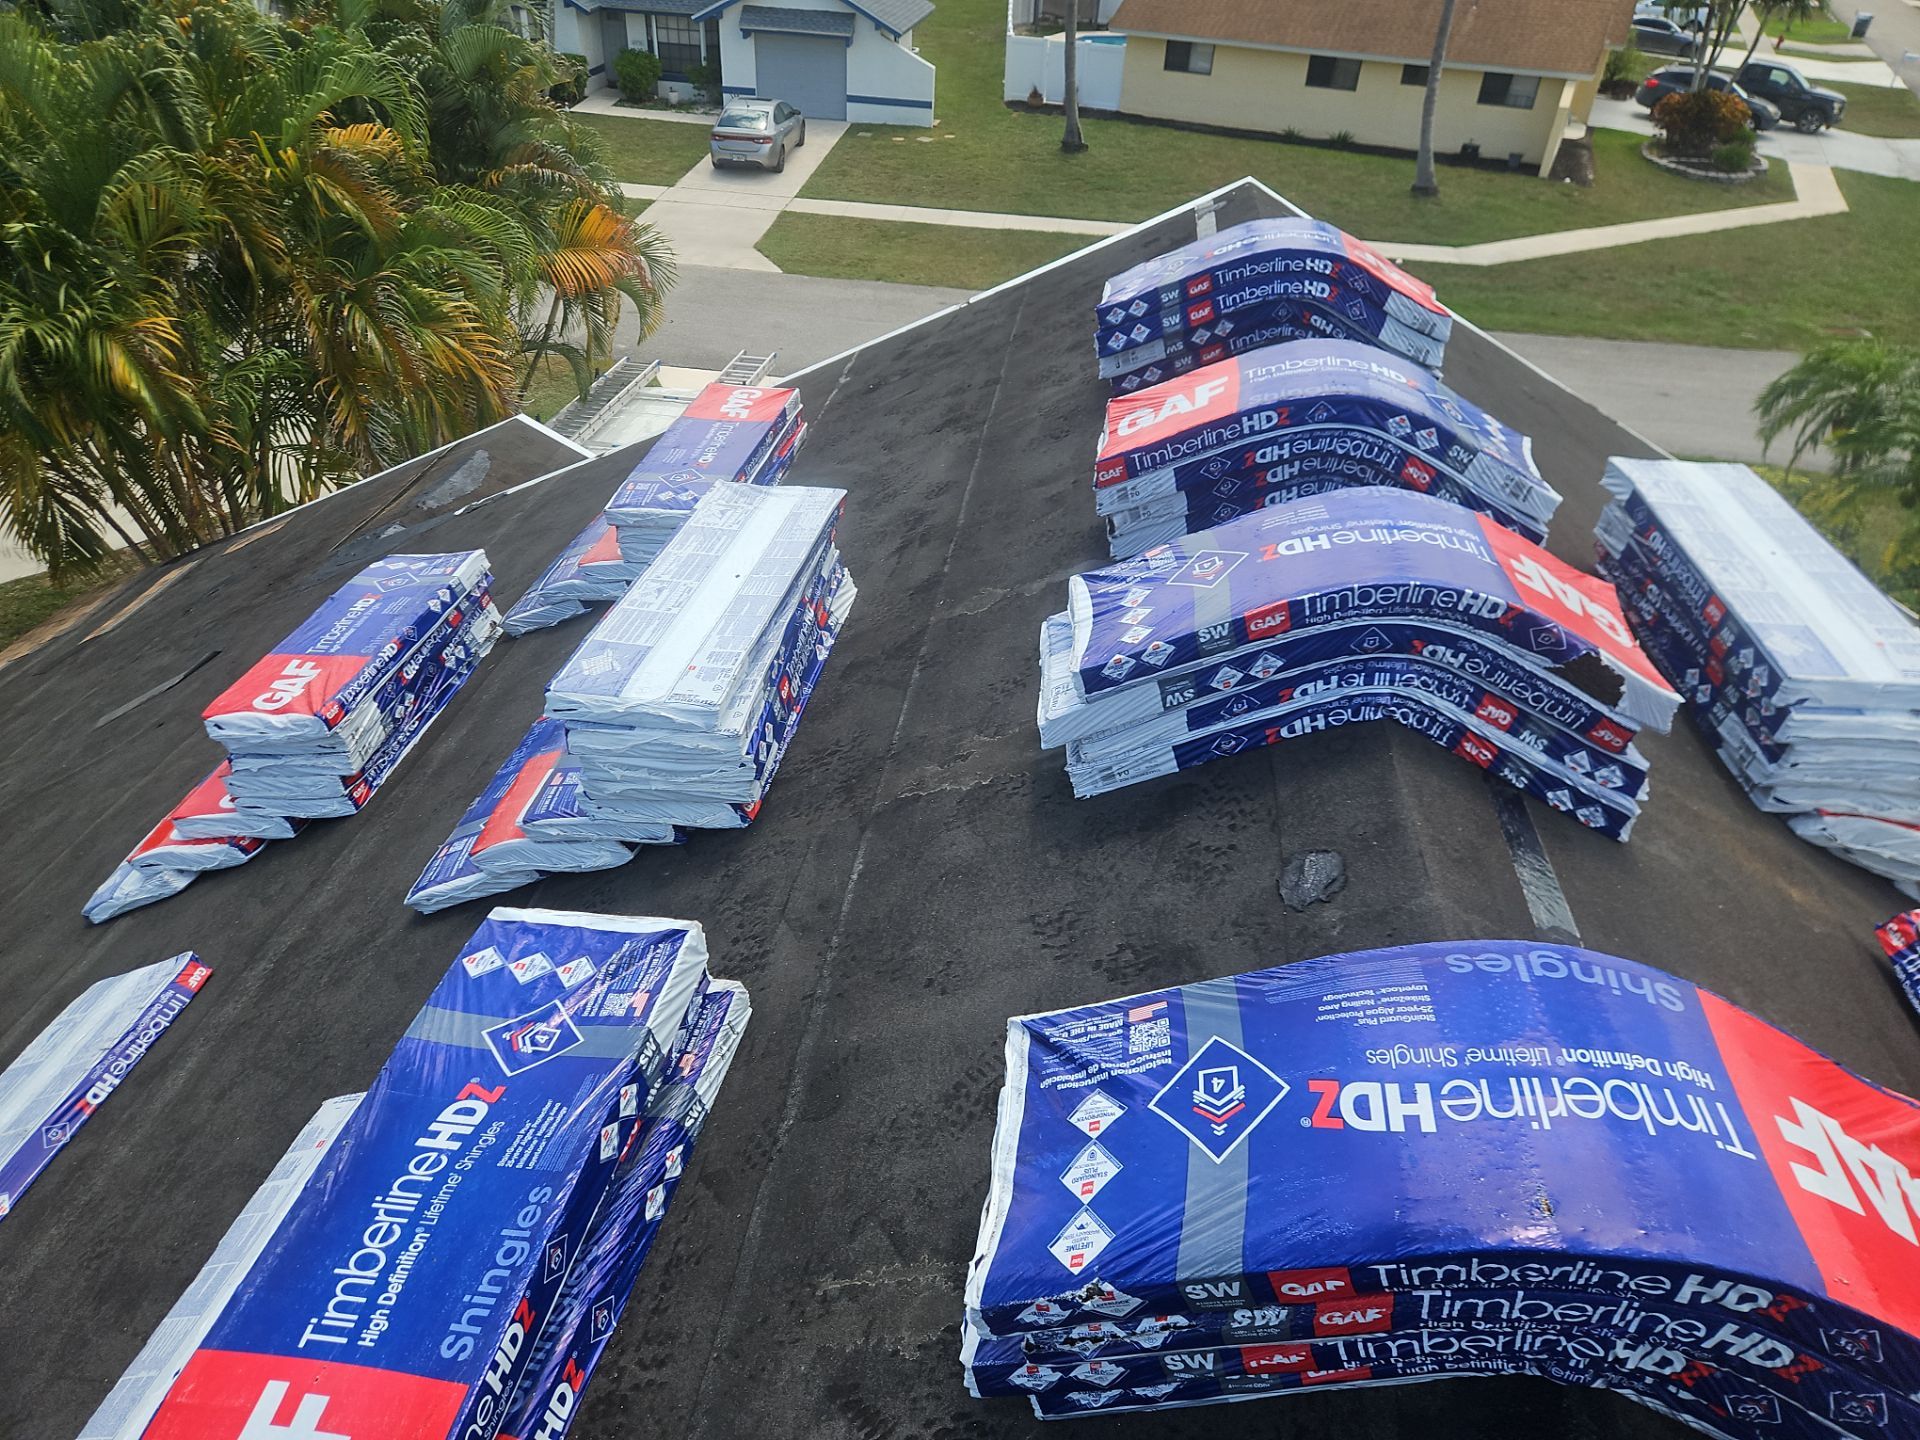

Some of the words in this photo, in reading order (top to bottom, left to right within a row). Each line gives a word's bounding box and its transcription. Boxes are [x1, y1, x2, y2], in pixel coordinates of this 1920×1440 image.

[1161, 289, 1180, 301] SW
[1189, 281, 1210, 295] GAF
[1162, 314, 1181, 327] SW
[1190, 306, 1211, 320] GAF
[720, 389, 763, 419] GAF
[1117, 376, 1228, 437] GAF
[1098, 466, 1124, 482] GAF
[1509, 553, 1639, 649] GAF
[1198, 622, 1230, 645] SW
[1250, 610, 1287, 633] GAF
[253, 660, 323, 711] GAF
[1165, 689, 1196, 708] SW
[326, 705, 340, 719] GAF
[1478, 704, 1512, 725] GAF
[1519, 730, 1549, 751] SW
[1592, 729, 1623, 747] GAF
[187, 966, 208, 989] GAF
[1444, 950, 1685, 1012] Shingles
[1322, 989, 1375, 1002] Technology
[1341, 998, 1375, 1008] Nailing
[1318, 1003, 1340, 1012] Area
[1365, 1006, 1395, 1016] Algae
[1397, 1005, 1434, 1013] 25-year
[1380, 1014, 1437, 1025] StainGuard
[639, 1039, 657, 1069] SW
[1101, 1049, 1171, 1069] Instrucciones
[1367, 1044, 1458, 1070] Shingles
[1087, 1062, 1099, 1074] de
[1111, 1057, 1173, 1077] Installation
[1668, 1061, 1716, 1091] High
[1056, 1071, 1109, 1091] instructions
[684, 1099, 706, 1129] SW
[1774, 1096, 1920, 1247] AF
[357, 1307, 391, 1347] High
[455, 1120, 505, 1171] Shingles
[1064, 1242, 1094, 1253] LIFETIME
[440, 1185, 553, 1361] Shingles
[1185, 1281, 1241, 1300] SW
[1280, 1280, 1346, 1296] GAF
[1319, 1308, 1387, 1325] GAF
[1166, 1353, 1215, 1371] SW
